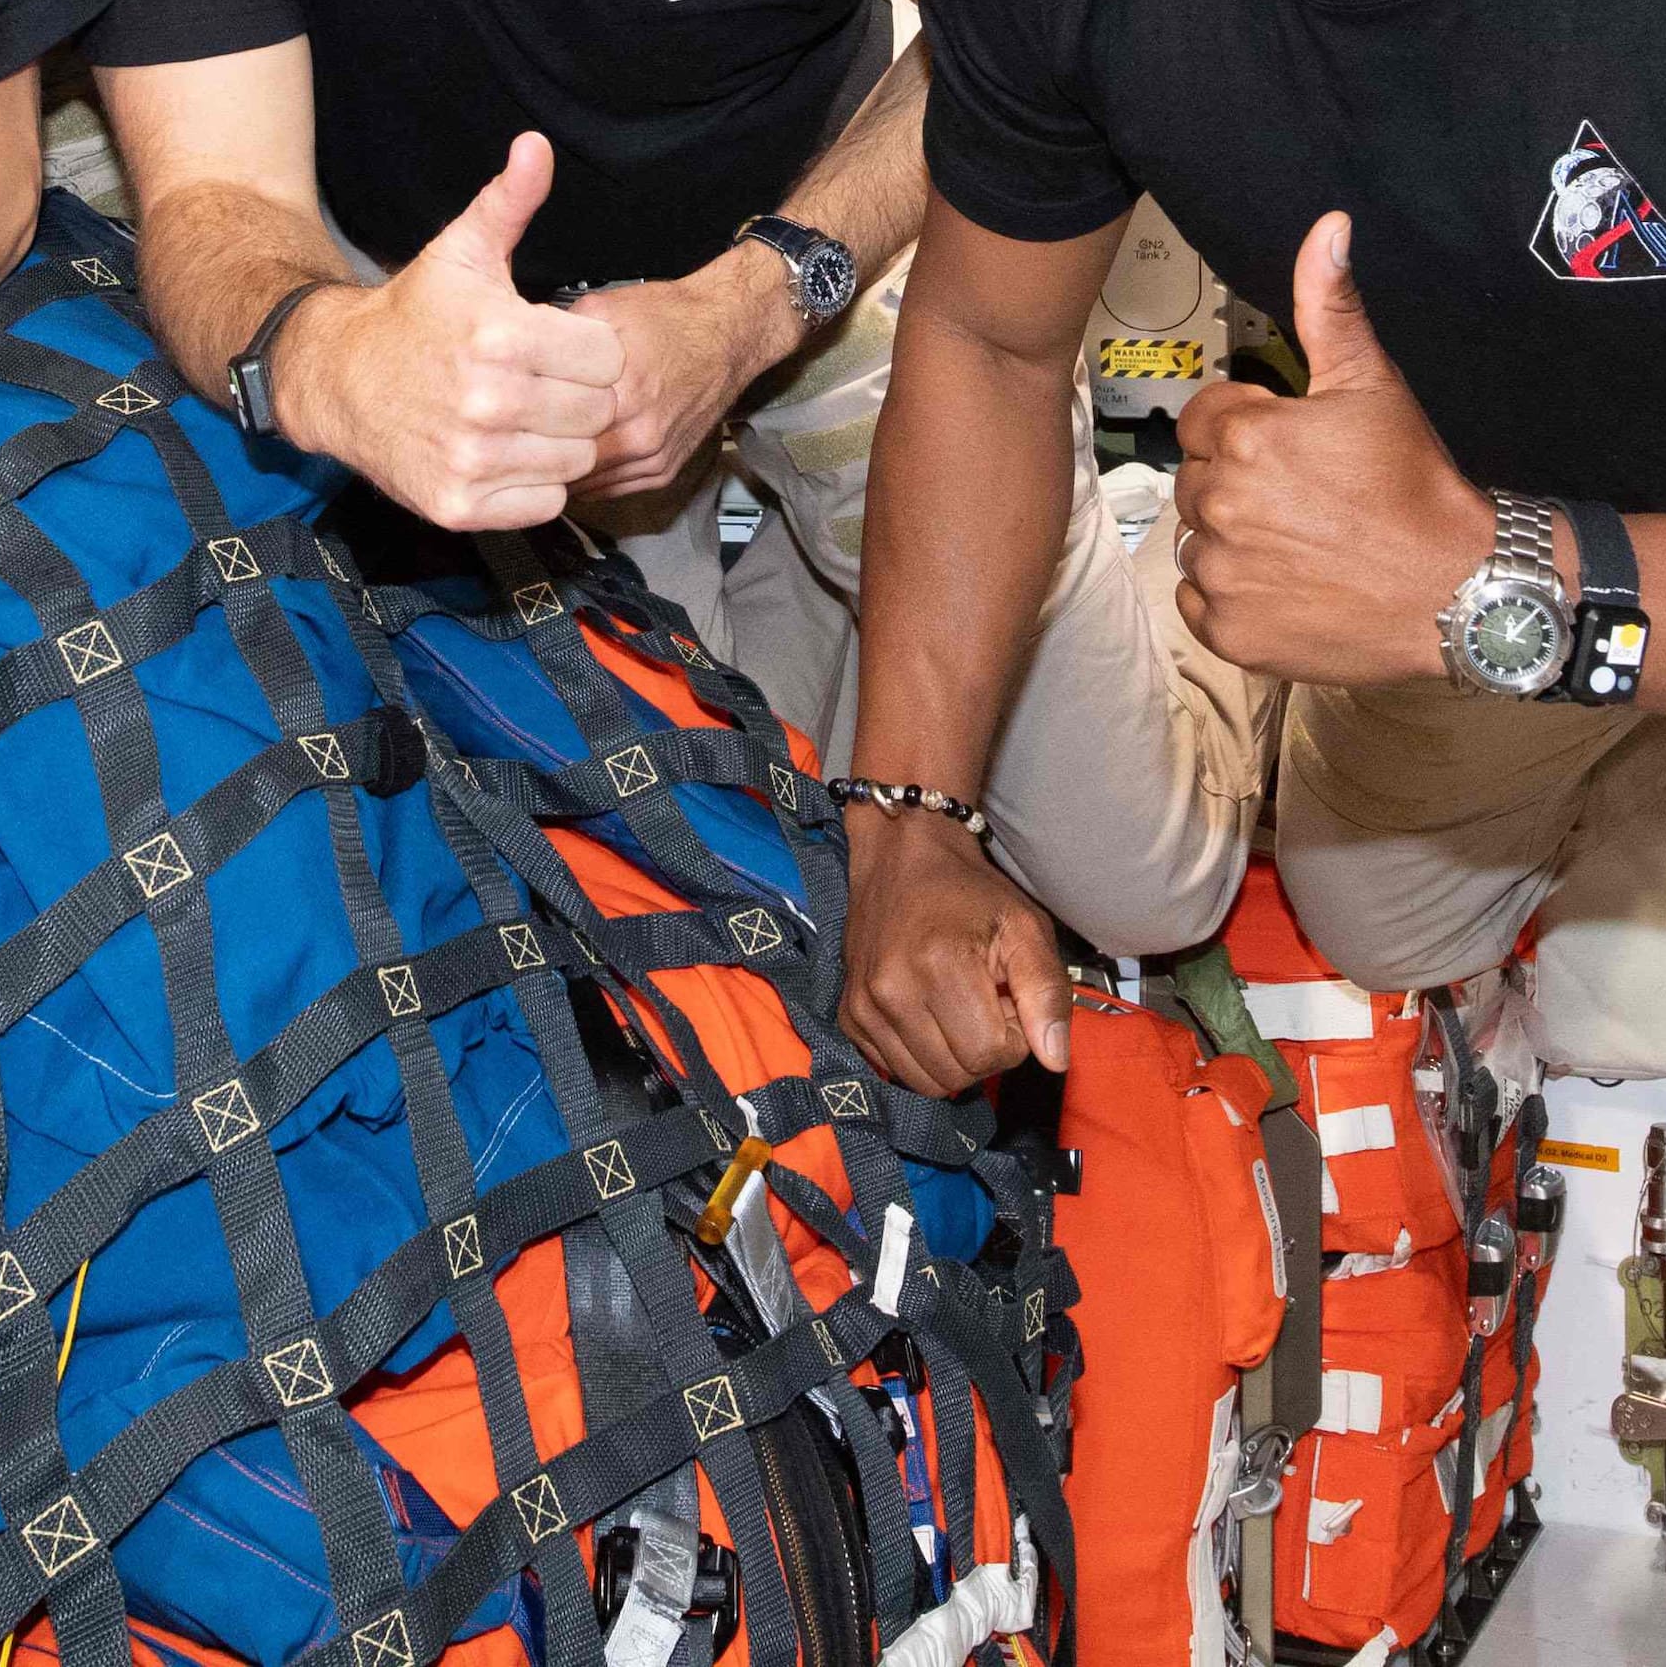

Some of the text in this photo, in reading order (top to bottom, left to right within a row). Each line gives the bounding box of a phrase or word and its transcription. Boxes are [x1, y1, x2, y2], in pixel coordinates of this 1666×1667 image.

[1138, 239, 1164, 250] GN2
[1134, 250, 1171, 260] Tank 2
[1114, 349, 1160, 357] WARNING
[1561, 1147, 1594, 1160] Medical
[1257, 1167, 1279, 1242] Mooring
